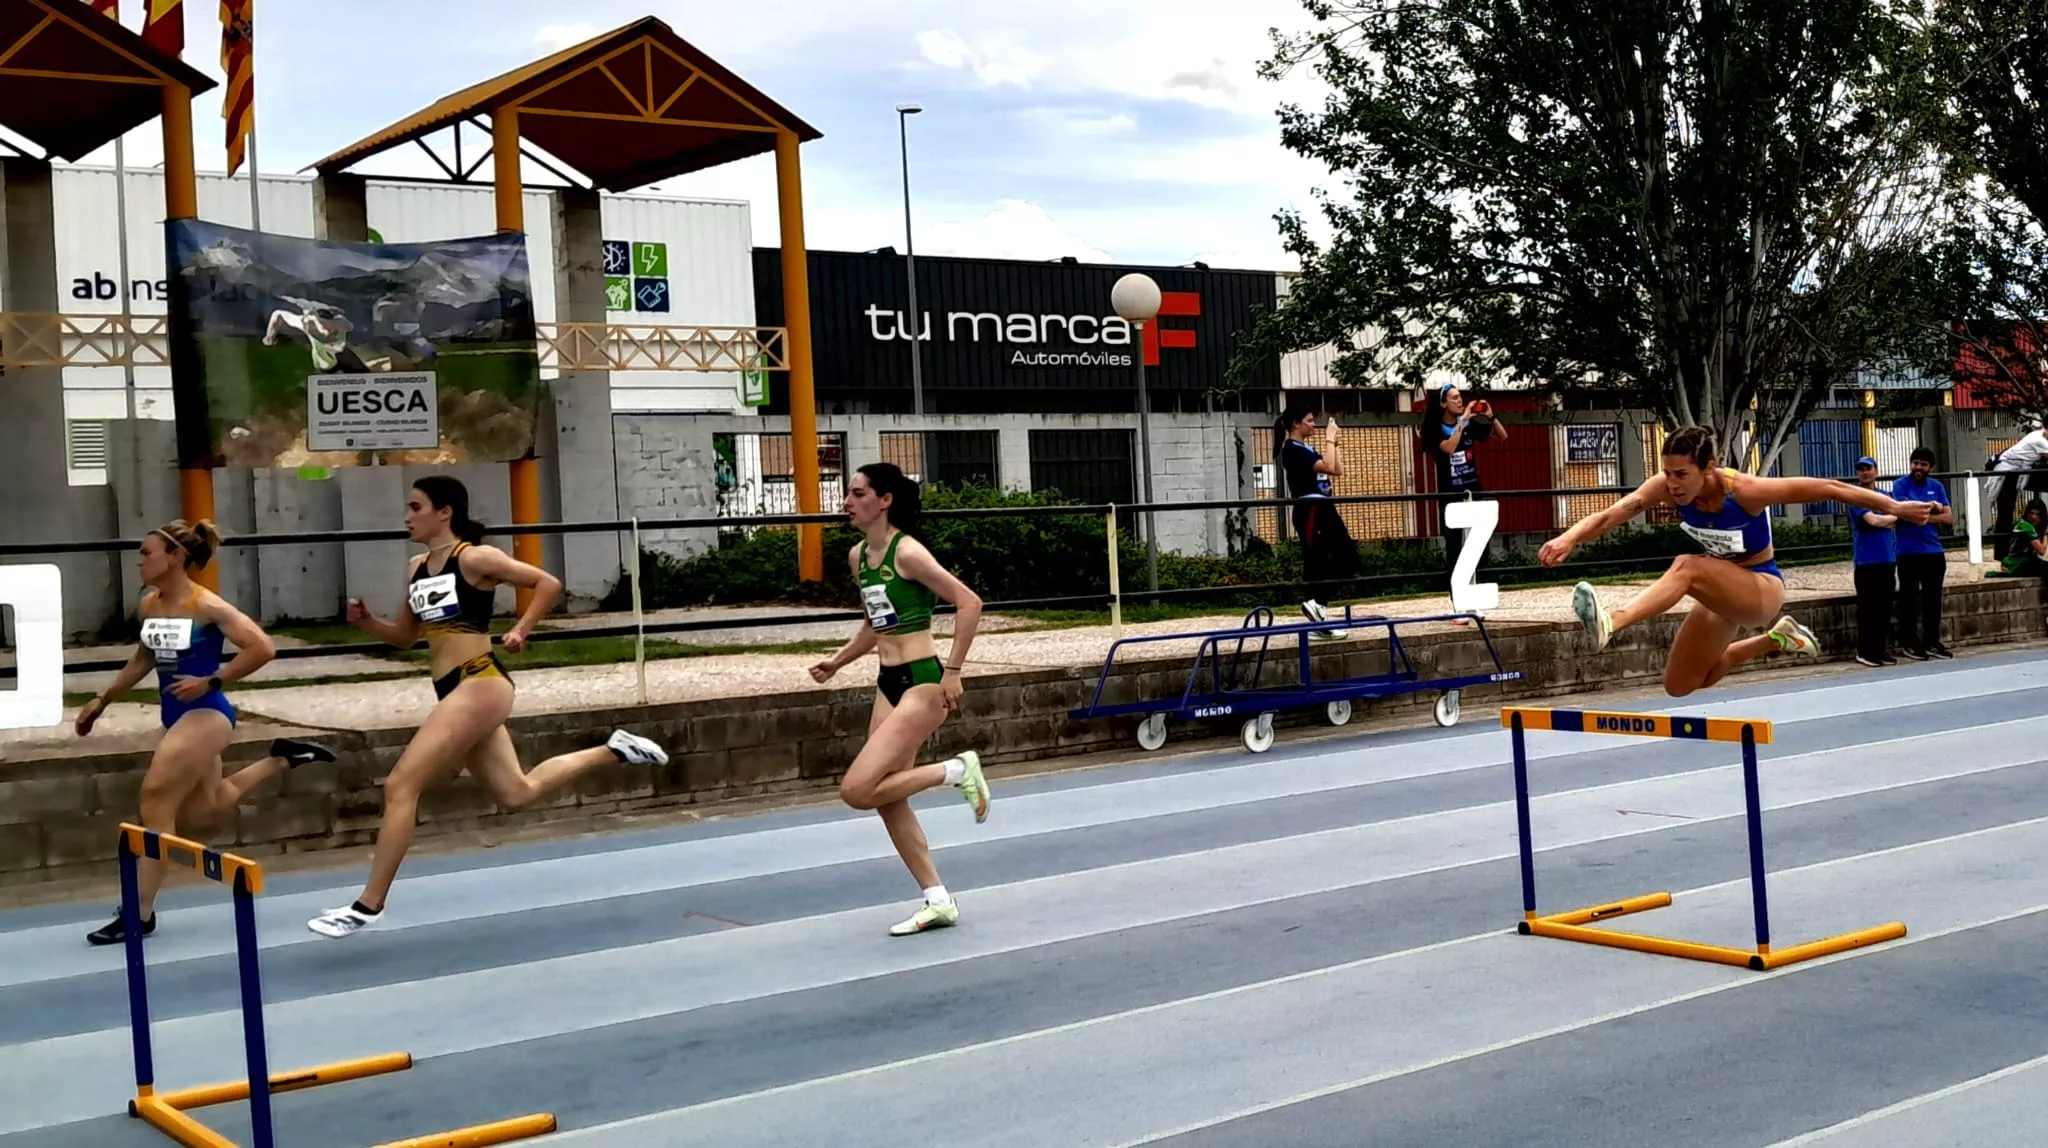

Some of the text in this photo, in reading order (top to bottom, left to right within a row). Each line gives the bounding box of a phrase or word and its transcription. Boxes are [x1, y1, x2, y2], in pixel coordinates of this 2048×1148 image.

[865, 304, 1131, 344] tu marca
[1011, 350, 1132, 366] Automóviles
[317, 389, 428, 415] UESCA
[412, 594, 425, 611] 10
[147, 633, 161, 647] 16
[1194, 705, 1232, 718] MONDO
[1596, 716, 1656, 733] MONDO
